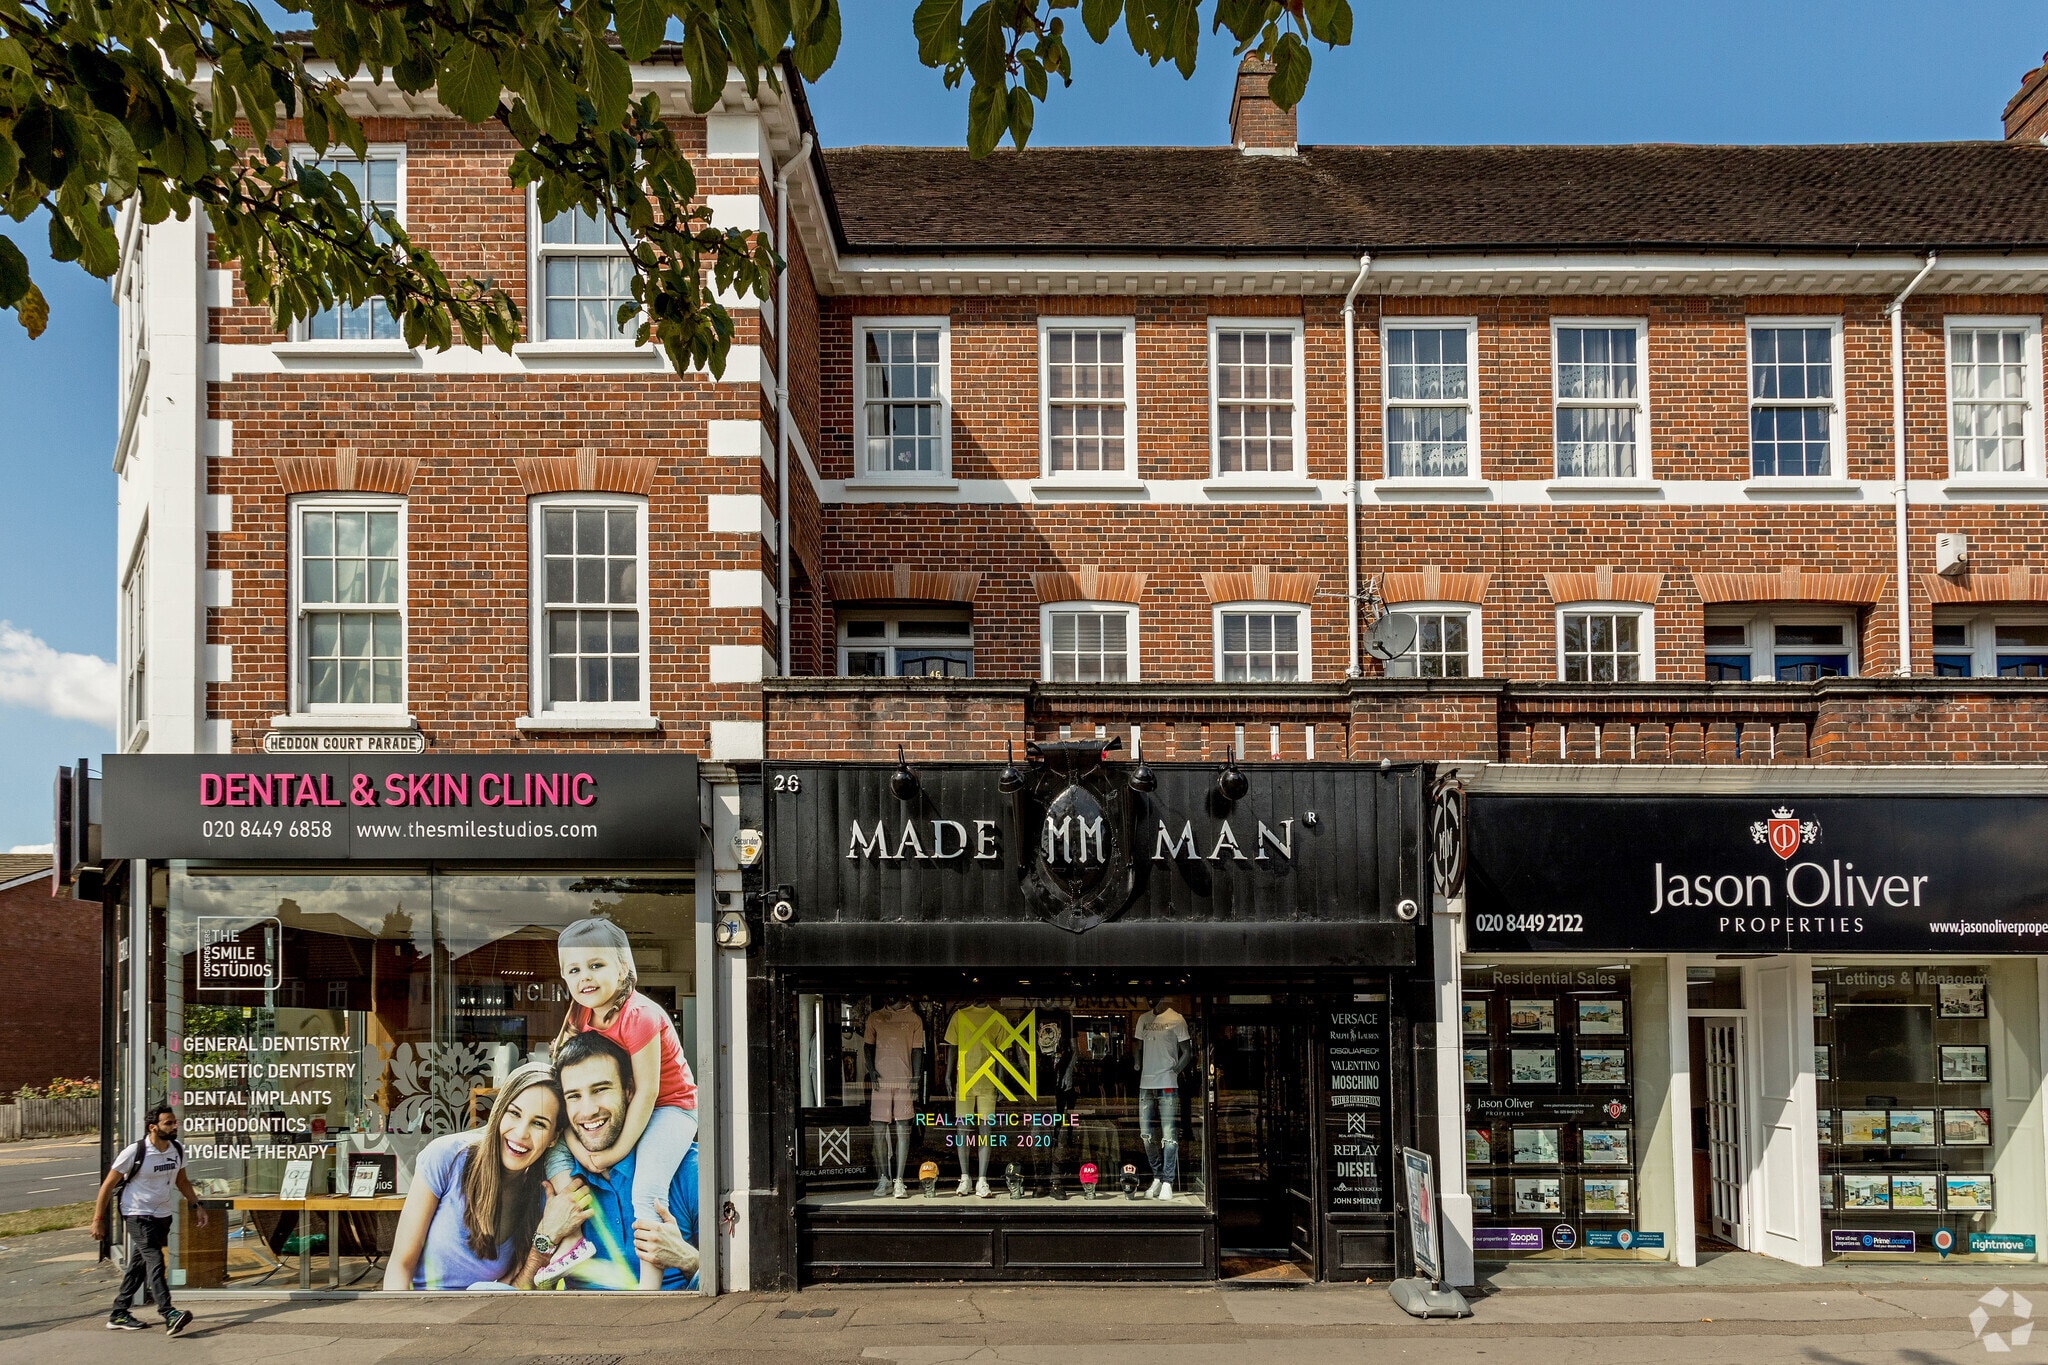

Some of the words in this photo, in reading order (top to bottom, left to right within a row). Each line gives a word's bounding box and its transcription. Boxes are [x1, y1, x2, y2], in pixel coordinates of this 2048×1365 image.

[270, 736, 319, 750] HEDDON
[323, 736, 364, 750] COURT
[368, 737, 417, 750] PARADE
[200, 773, 341, 806] DENTAL
[350, 773, 375, 806] &
[385, 773, 468, 806] SKIN
[478, 773, 594, 806] CLINIC
[773, 774, 799, 792] 26
[203, 820, 235, 838] 020
[240, 820, 283, 838] 8449
[288, 820, 332, 838] 6858
[356, 819, 598, 838] www.thesmilestudios.com
[846, 818, 997, 859] MADE
[1151, 817, 1295, 859] MAN
[1650, 862, 1772, 914] Jason
[1786, 859, 1929, 908] Oliver
[1476, 914, 1503, 932] 020
[1506, 914, 1545, 932] 8449
[1547, 914, 1584, 932] 2122
[1719, 917, 1864, 933] PROPERTIES
[211, 929, 240, 943] THE
[203, 929, 211, 977] COCKFOSTERS
[211, 946, 256, 960] SMILE
[211, 960, 272, 977] STÜDIOS
[1493, 971, 1572, 985] Residential
[1577, 971, 1616, 985] Sales
[1836, 971, 1895, 988] Lettings
[1900, 971, 1911, 985] &
[1331, 1013, 1378, 1025] VERSACE
[183, 1036, 258, 1051] GENERAL
[262, 1036, 351, 1051] DENTISTRY
[183, 1063, 264, 1079] COSMETIC
[268, 1063, 356, 1079] DENTISTRY
[1331, 1060, 1380, 1071] VALENTINO
[1331, 1075, 1379, 1090] MOSCHINO
[183, 1090, 247, 1106] DENTAL
[251, 1090, 332, 1106] IMPLANTS
[1477, 1097, 1503, 1109] Jason
[1504, 1097, 1535, 1109] Oliver
[183, 1117, 306, 1132] ORTHODONTICS
[915, 1113, 953, 1127] REAL
[955, 1113, 1020, 1127] ARTISTIC
[1023, 1113, 1080, 1127] PEOPLE
[945, 1134, 1008, 1147] SUMMER
[1017, 1134, 1051, 1147] 2020
[183, 1144, 251, 1159] HYGIENE
[255, 1144, 329, 1159] THERAPY
[1333, 1144, 1380, 1156] REPLAY
[153, 1163, 176, 1173] PUMA
[818, 1167, 844, 1176] ARTISTIC
[844, 1166, 868, 1174] PEOPLE
[1337, 1161, 1378, 1177] DIESEL
[1333, 1197, 1352, 1205] JOHN
[1352, 1197, 1383, 1205] SMEDLEY
[1510, 1233, 1539, 1243] Zoopla
[1873, 1237, 1912, 1245] PrimeLocation
[1972, 1239, 2025, 1252] rightmove
